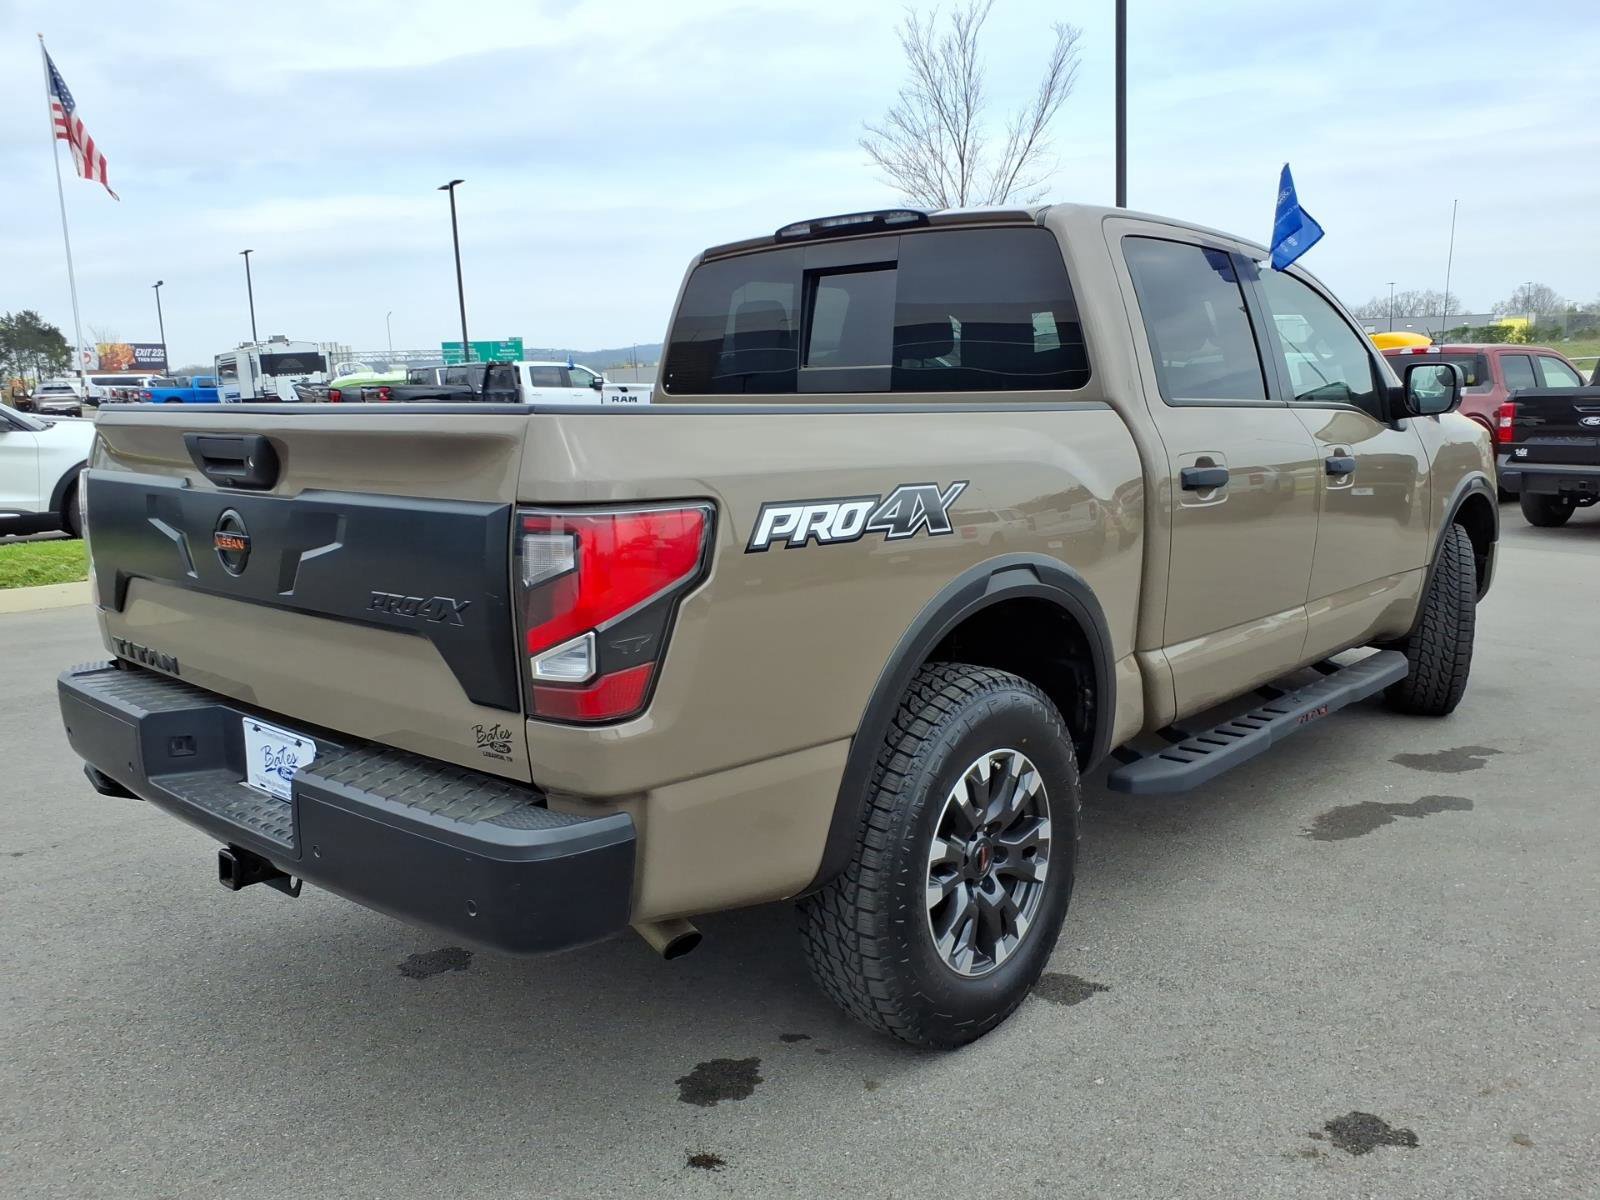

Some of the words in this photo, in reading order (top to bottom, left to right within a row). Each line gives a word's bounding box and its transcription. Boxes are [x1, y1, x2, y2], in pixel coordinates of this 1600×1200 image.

[135, 349, 152, 357] EXIT
[214, 536, 246, 551] NISSAN
[112, 635, 180, 676] TITAN
[471, 723, 512, 743] Bates
[260, 745, 299, 767] Bates
